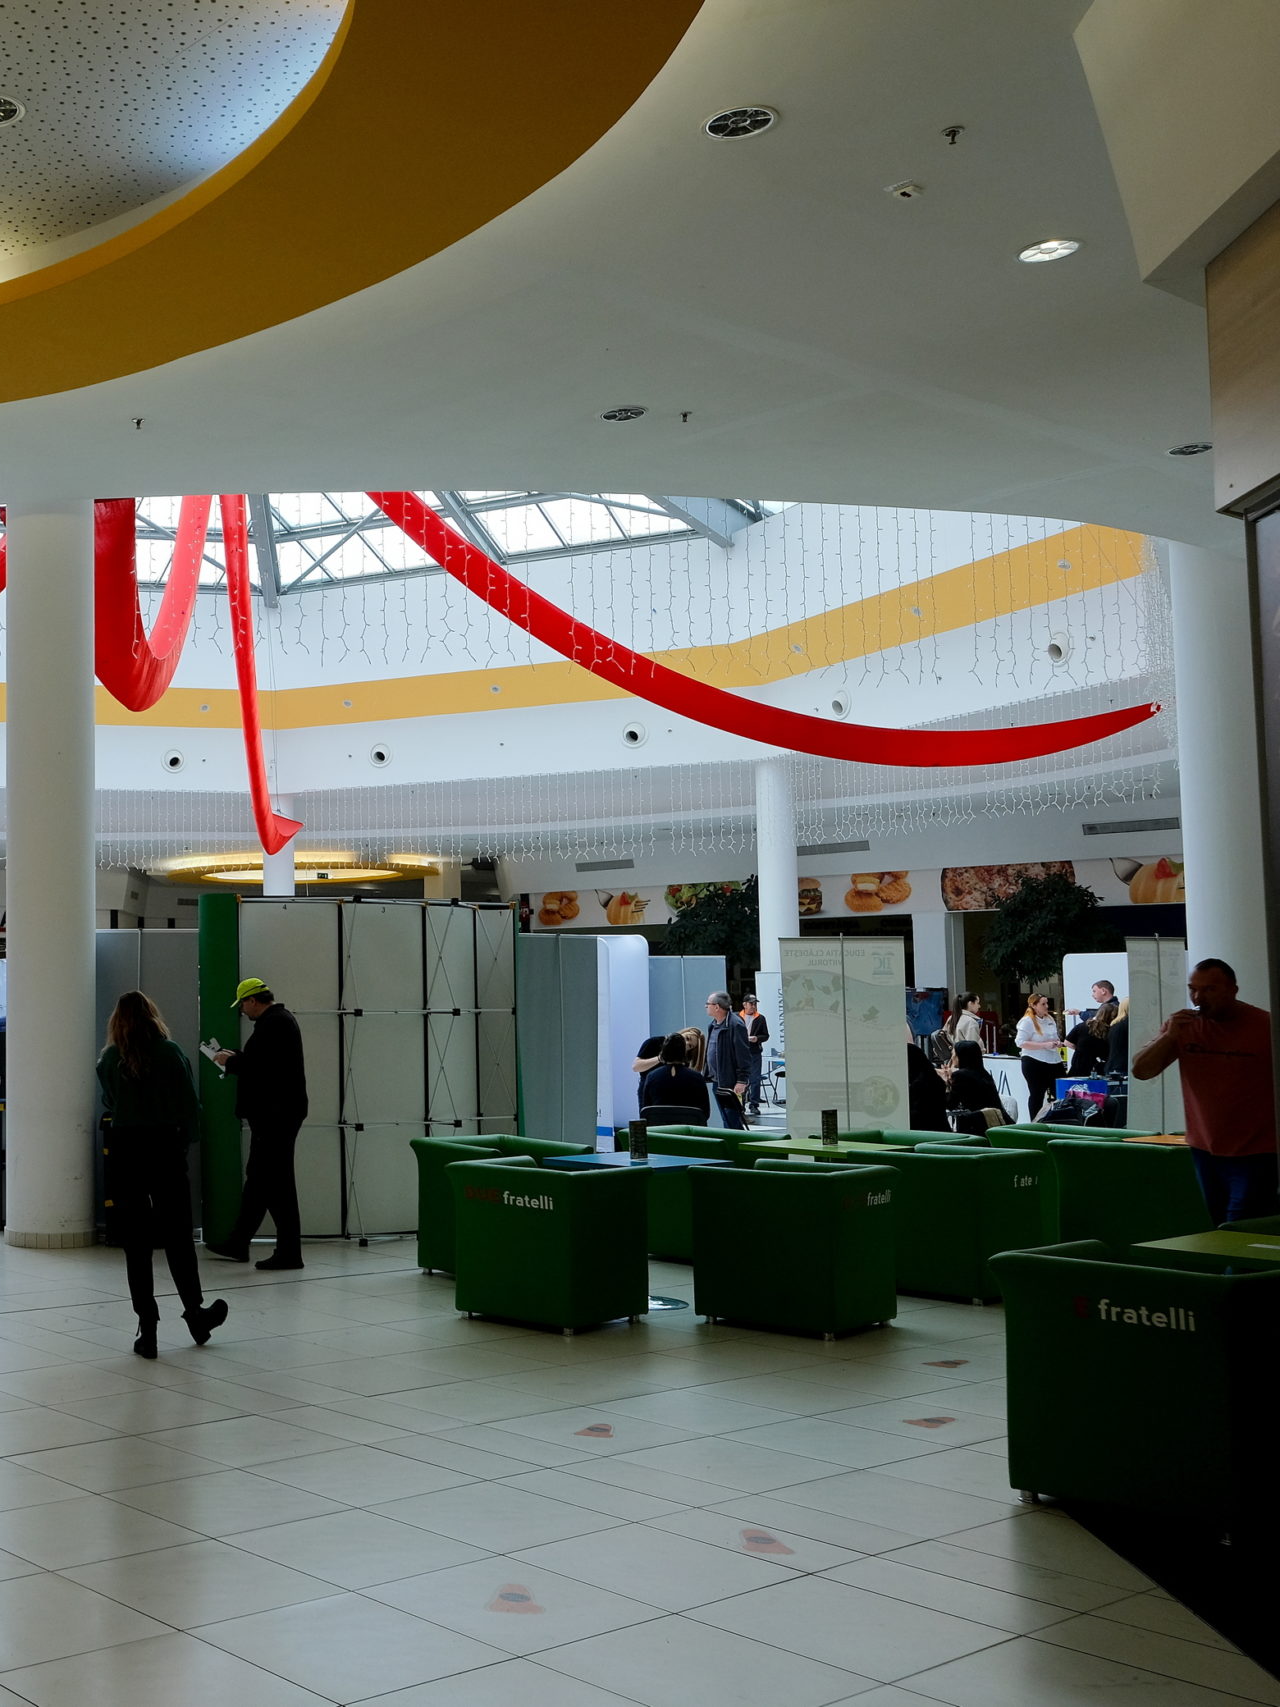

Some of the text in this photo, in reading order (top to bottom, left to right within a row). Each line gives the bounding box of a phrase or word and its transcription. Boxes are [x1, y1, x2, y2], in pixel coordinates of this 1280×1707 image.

[503, 1190, 553, 1211] fratelli
[867, 1188, 892, 1207] fratelli
[1097, 1298, 1197, 1332] fratelli
